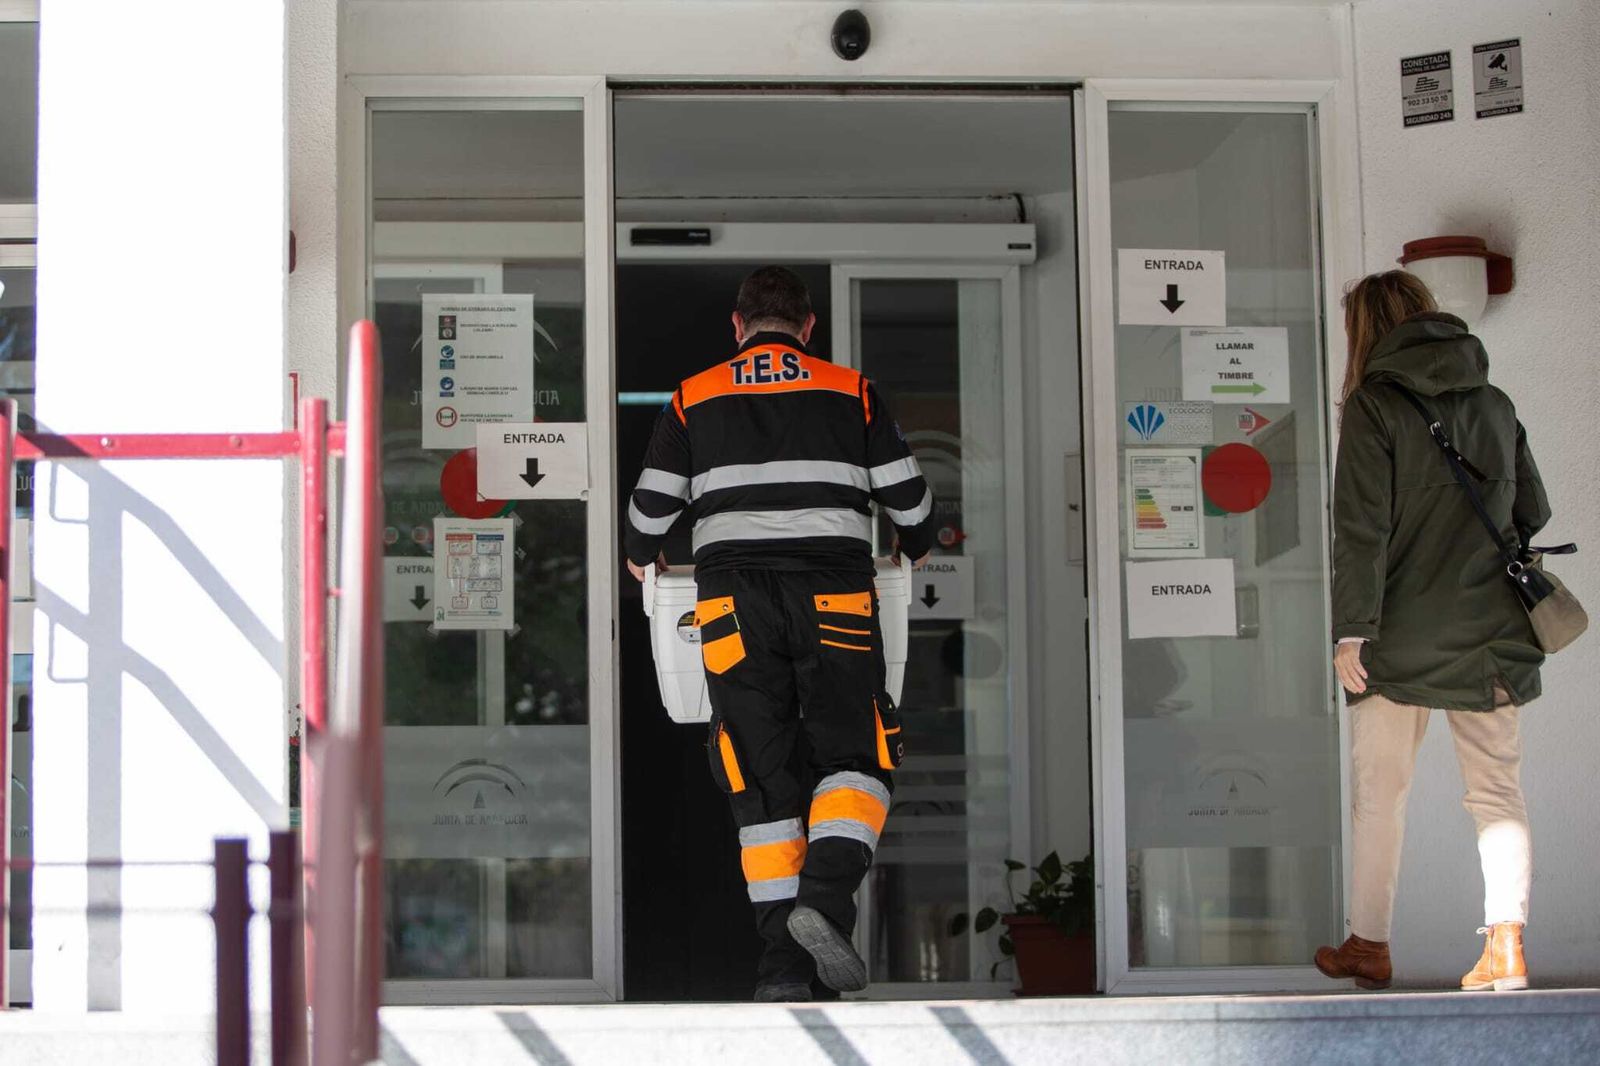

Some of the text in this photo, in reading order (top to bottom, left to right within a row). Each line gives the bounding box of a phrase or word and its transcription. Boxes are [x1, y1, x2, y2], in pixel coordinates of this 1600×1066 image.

[1402, 54, 1449, 69] CONECTADA
[1144, 260, 1204, 271] ENTRADA
[1216, 342, 1254, 350] LLAMAR
[1229, 357, 1241, 365] AL
[729, 351, 811, 385] T.E.S.
[1218, 372, 1254, 380] TIMBRE
[504, 433, 565, 444] ENTRADA
[396, 565, 434, 574] ENTRA
[912, 563, 957, 573] TRADA
[1151, 584, 1212, 596] ENTRADA
